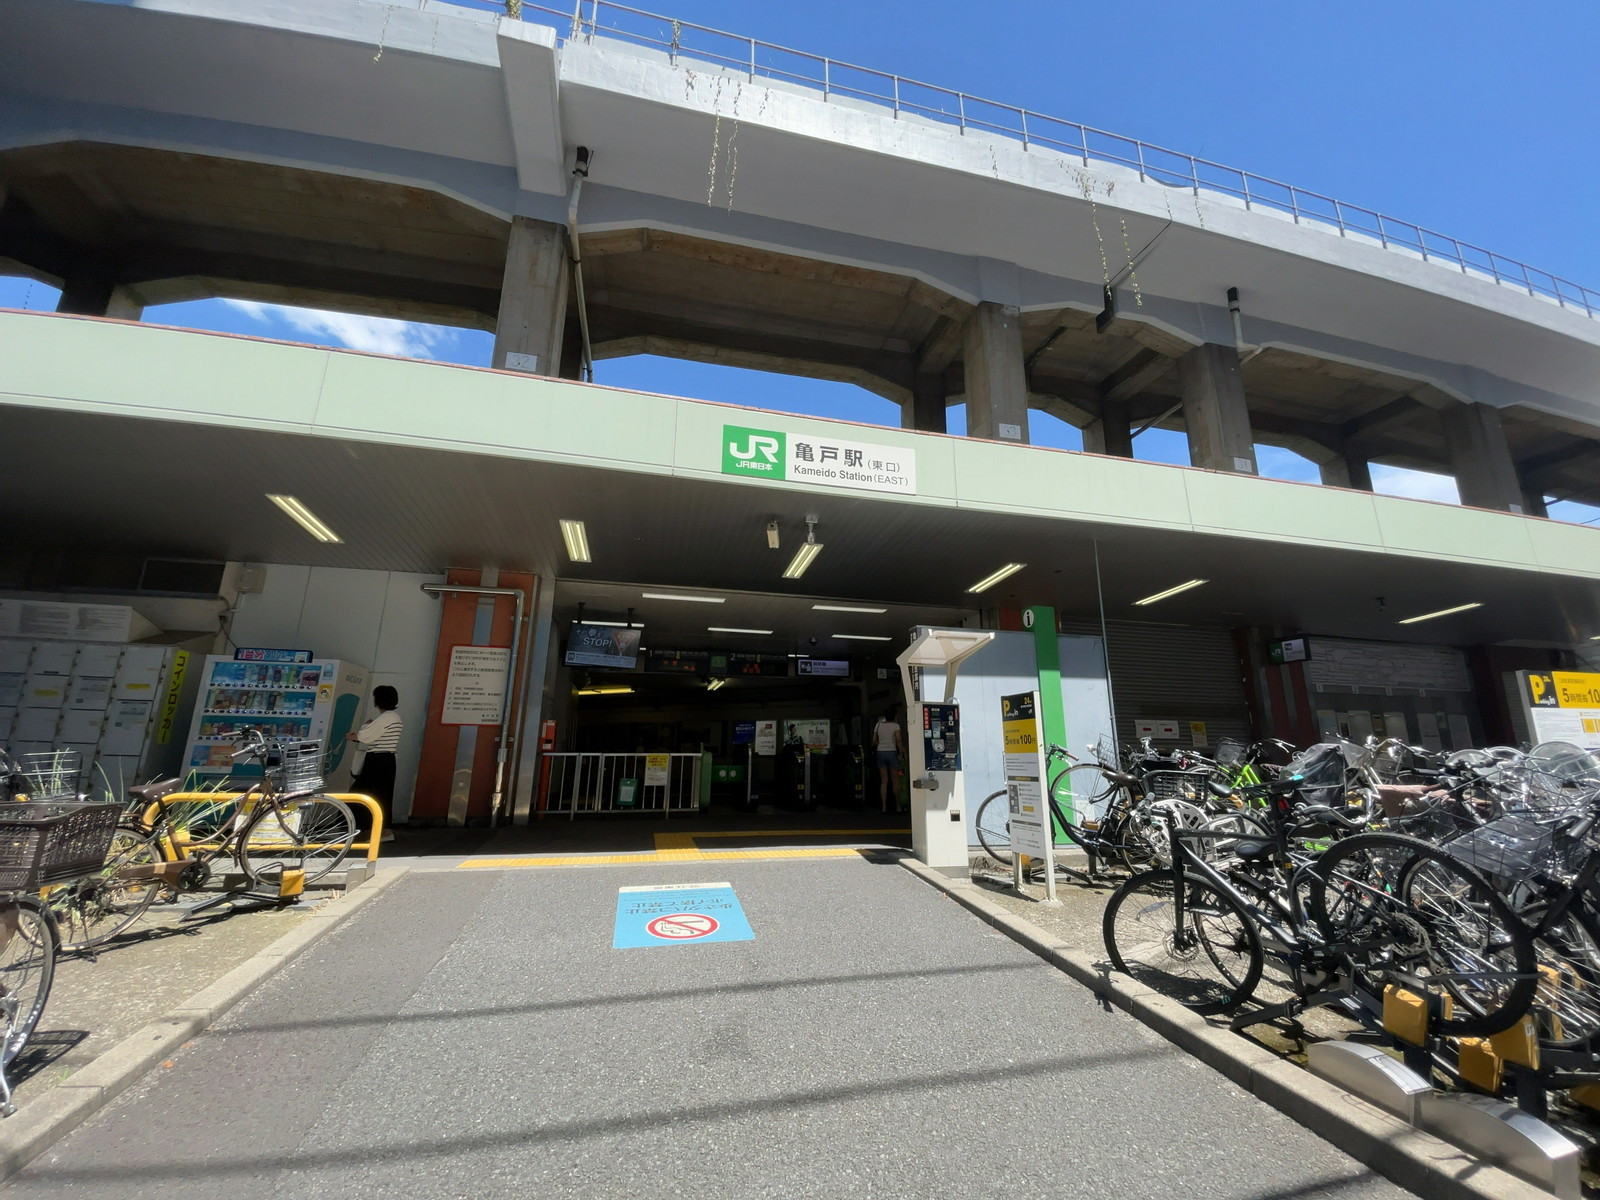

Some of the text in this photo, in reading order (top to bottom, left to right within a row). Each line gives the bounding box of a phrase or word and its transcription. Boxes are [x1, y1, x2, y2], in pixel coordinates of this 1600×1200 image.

[729, 435, 779, 463] JR
[736, 461, 773, 471] JR東日本
[794, 465, 837, 479] Kameido
[582, 637, 613, 648] STOP!
[161, 655, 187, 743] コインロッカー
